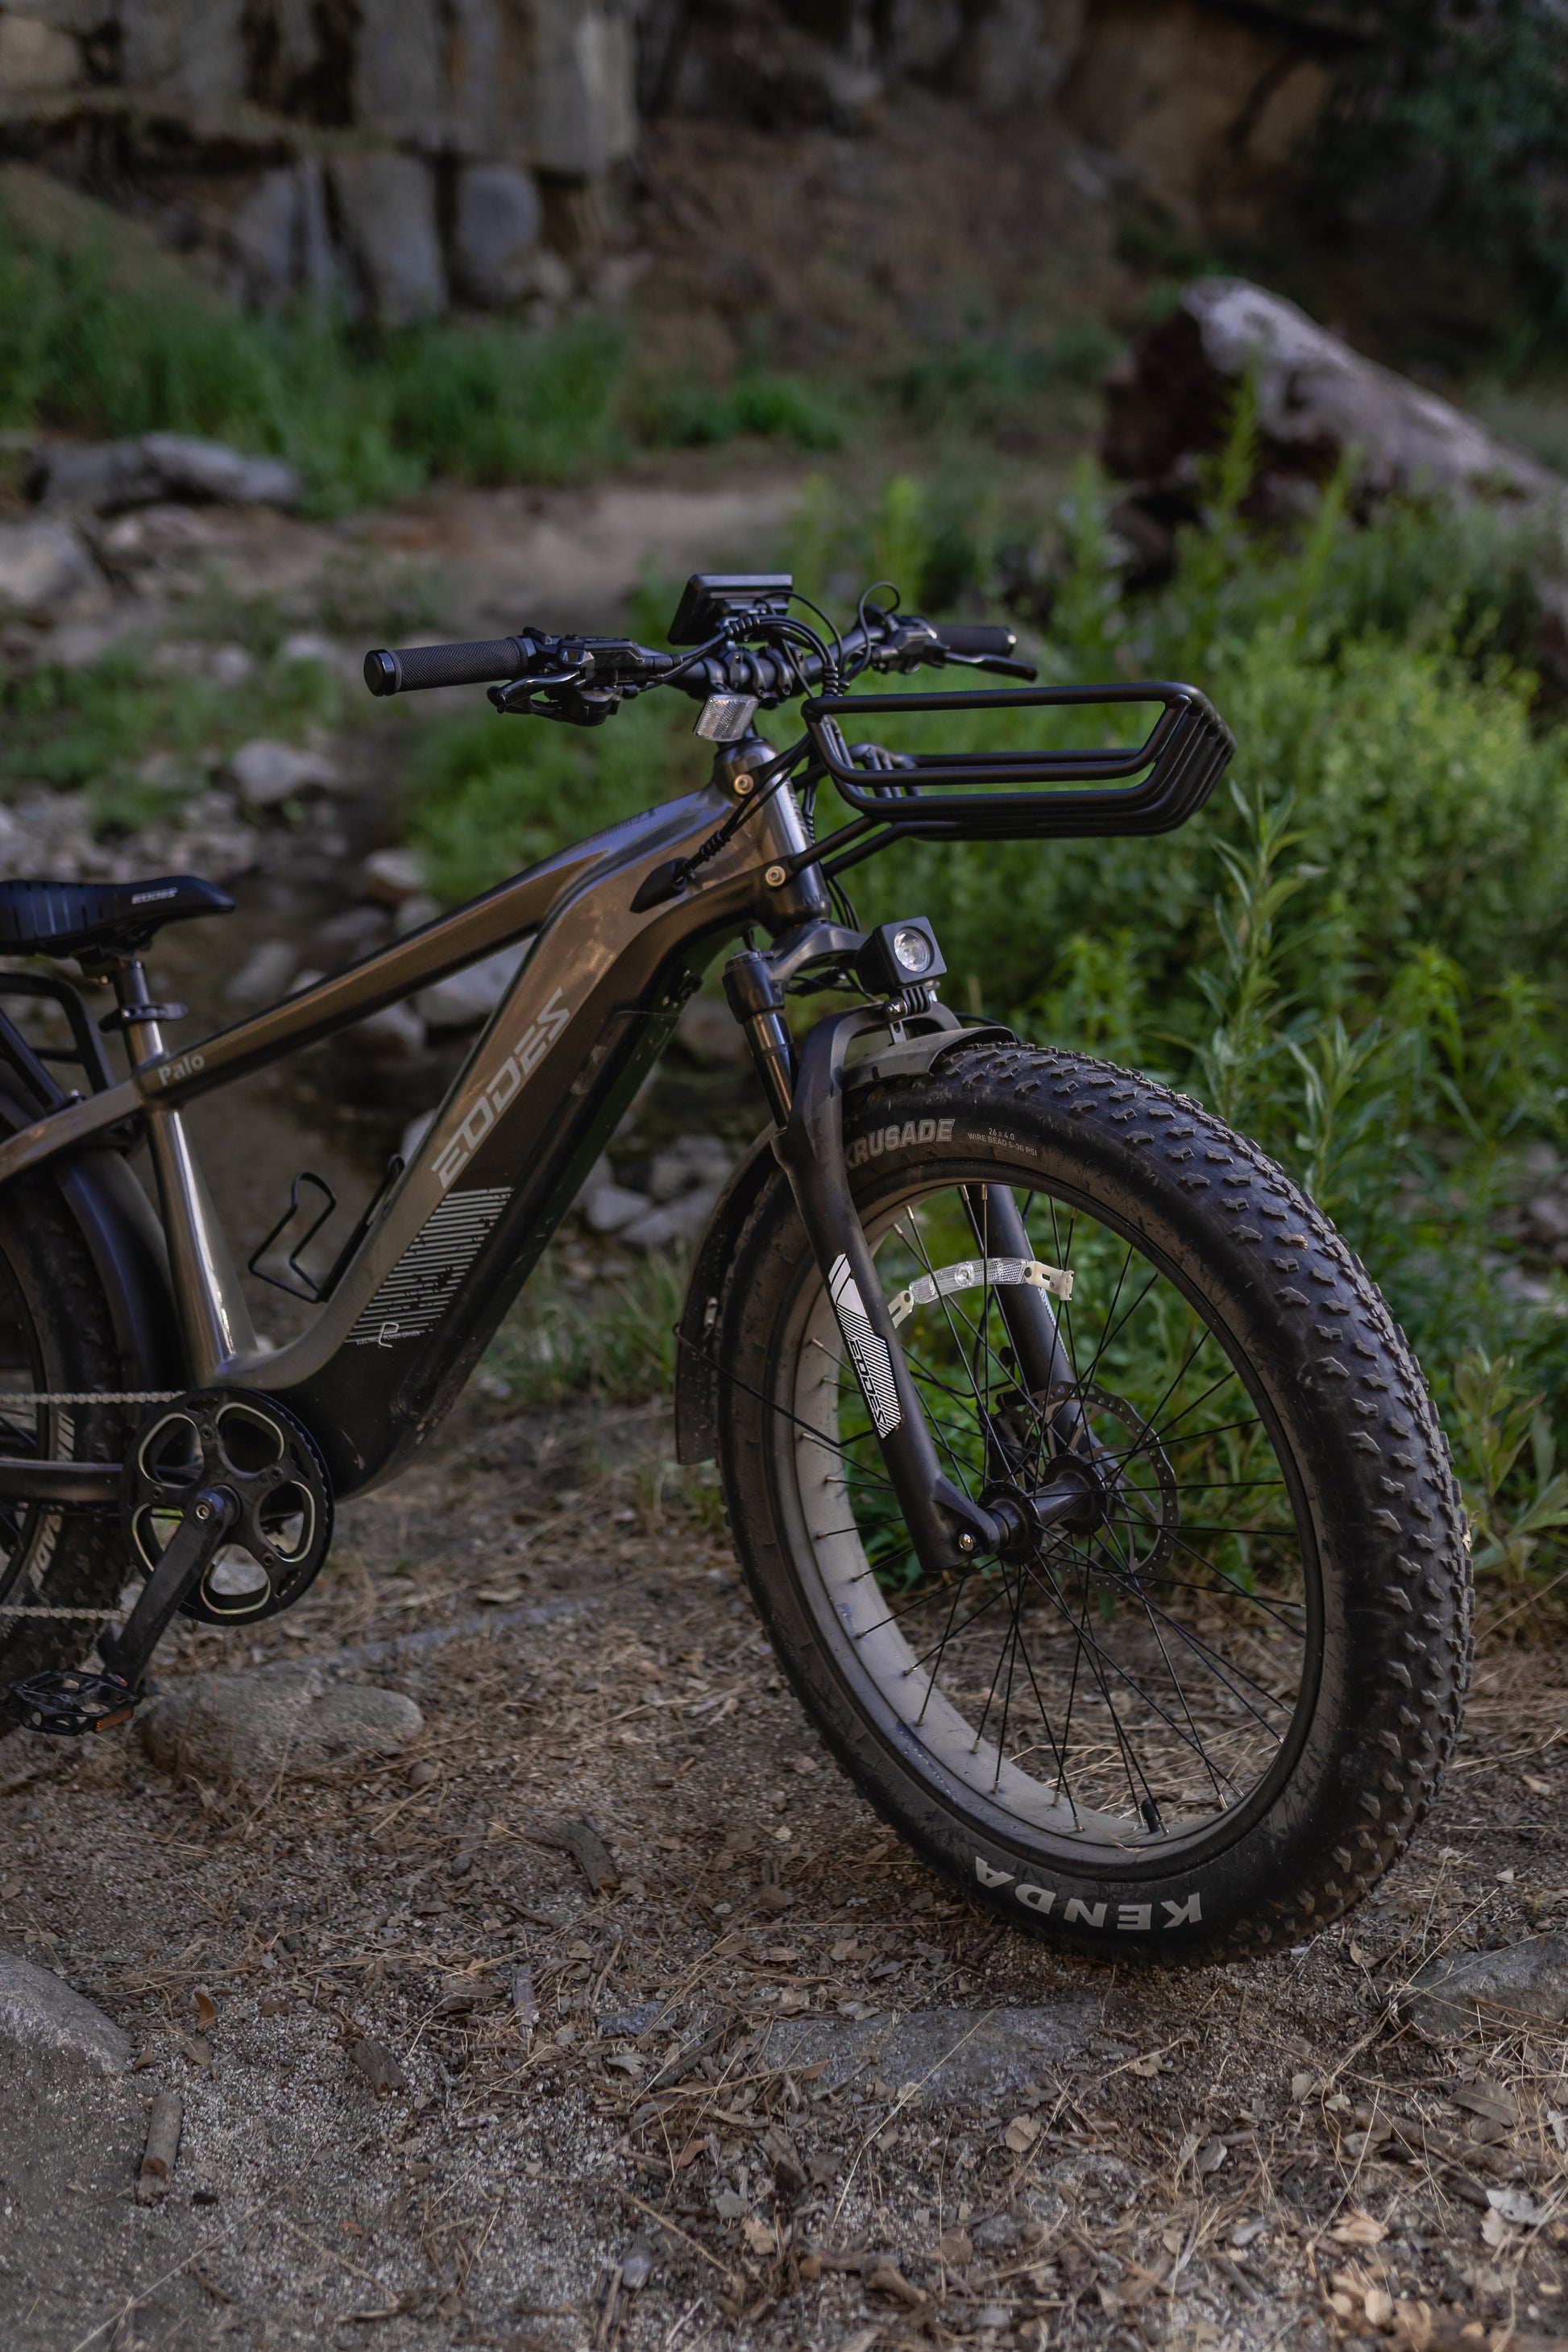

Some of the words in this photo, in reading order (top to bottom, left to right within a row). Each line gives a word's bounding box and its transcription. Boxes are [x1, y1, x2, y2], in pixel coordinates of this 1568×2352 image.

[158, 1055, 205, 1086] Palo
[967, 1132, 987, 1142] WIRE
[987, 1136, 1007, 1147] BEAD
[1008, 1141, 1024, 1152] 5-30
[1025, 1147, 1038, 1157] PSI
[988, 1128, 998, 1136] 26
[1004, 1132, 1015, 1141] 4.0
[975, 1856, 1203, 1931] KENDA
